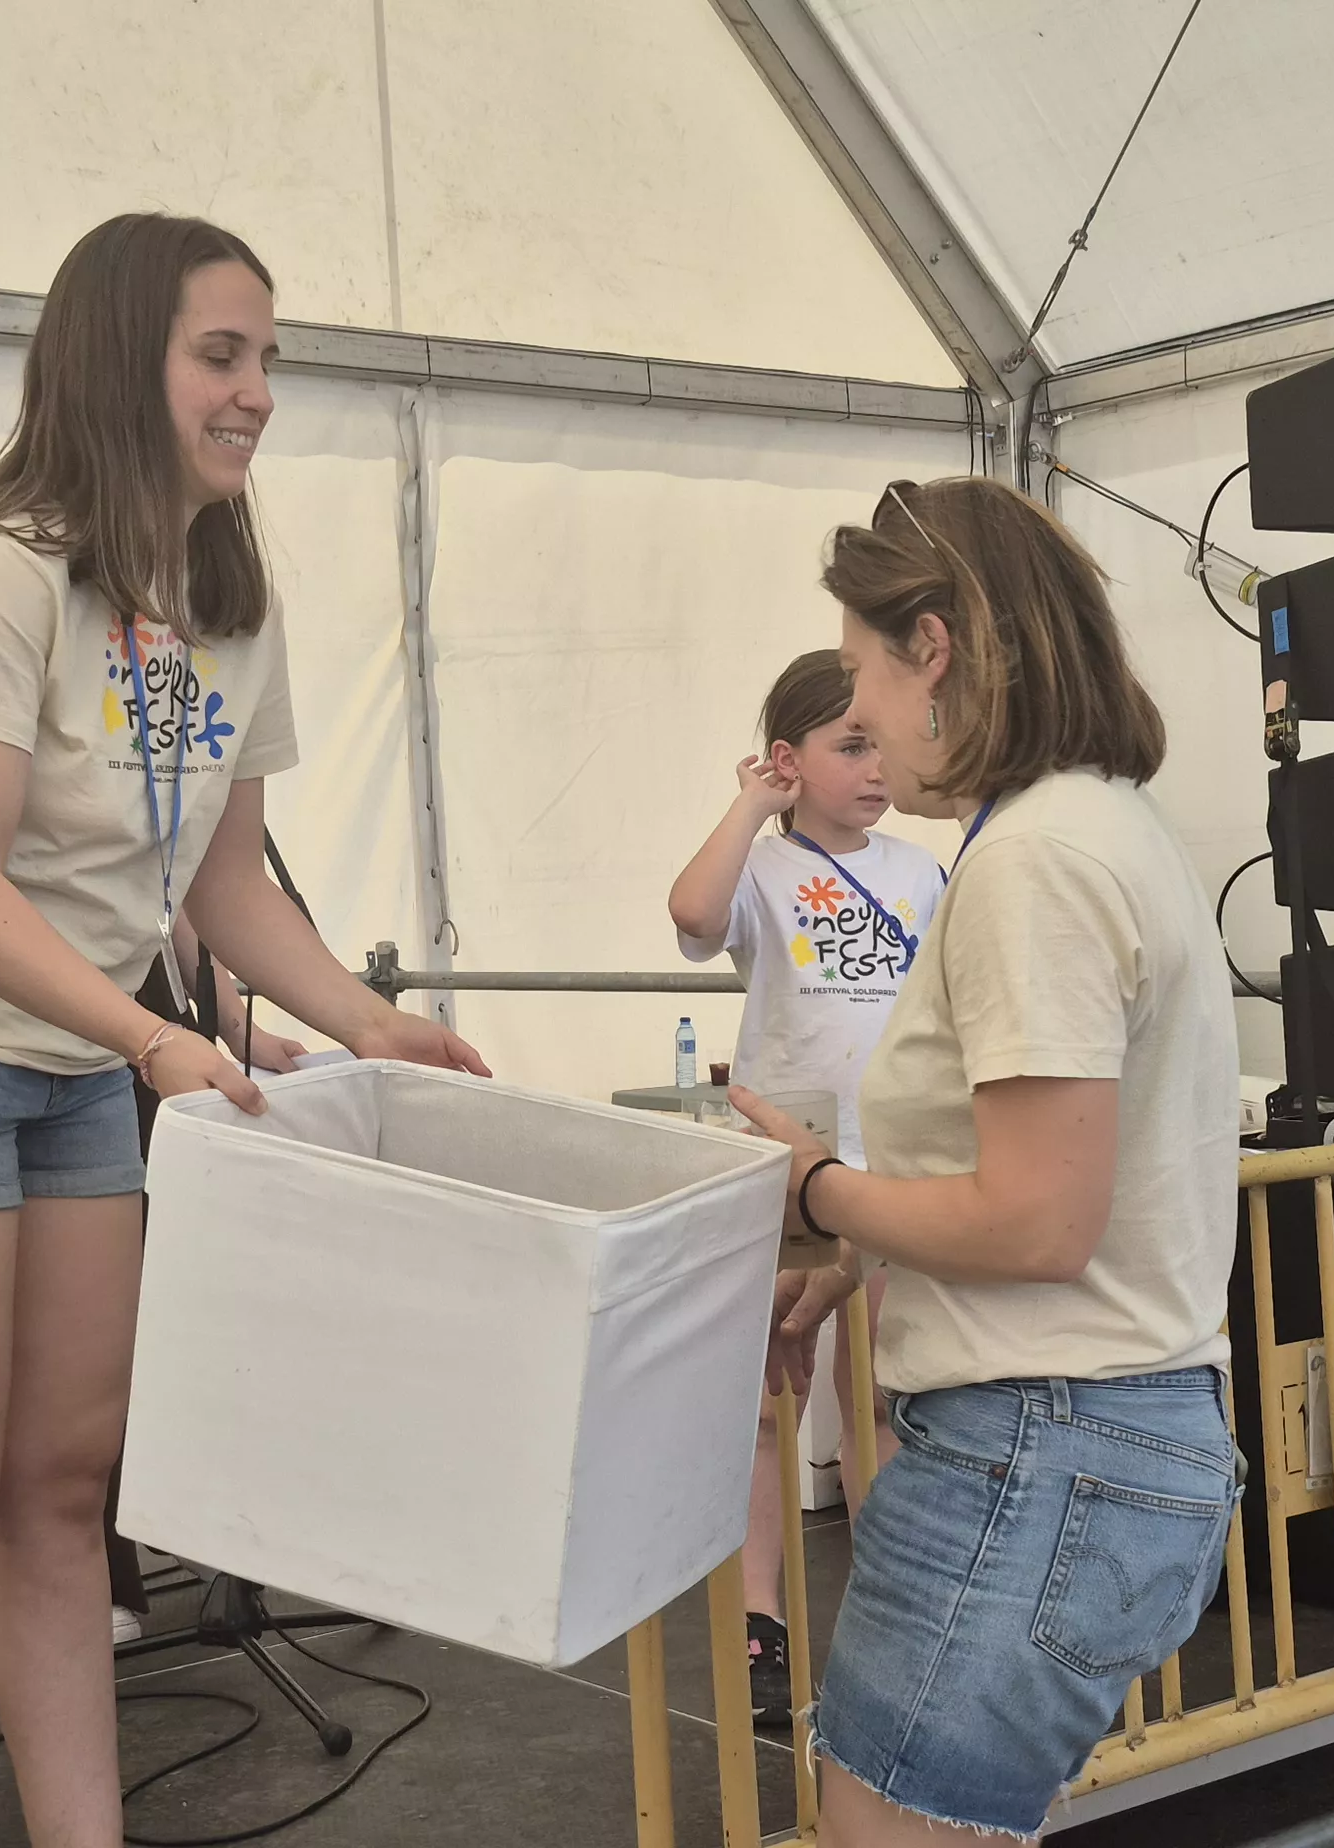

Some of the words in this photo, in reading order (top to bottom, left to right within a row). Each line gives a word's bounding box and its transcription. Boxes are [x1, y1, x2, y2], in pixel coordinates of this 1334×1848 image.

[123, 762, 153, 773] FESTIV
[814, 939, 899, 981] FEST
[799, 987, 811, 995] III
[813, 987, 851, 995] FESTIVAL
[853, 988, 897, 997] SOLIDARIO
